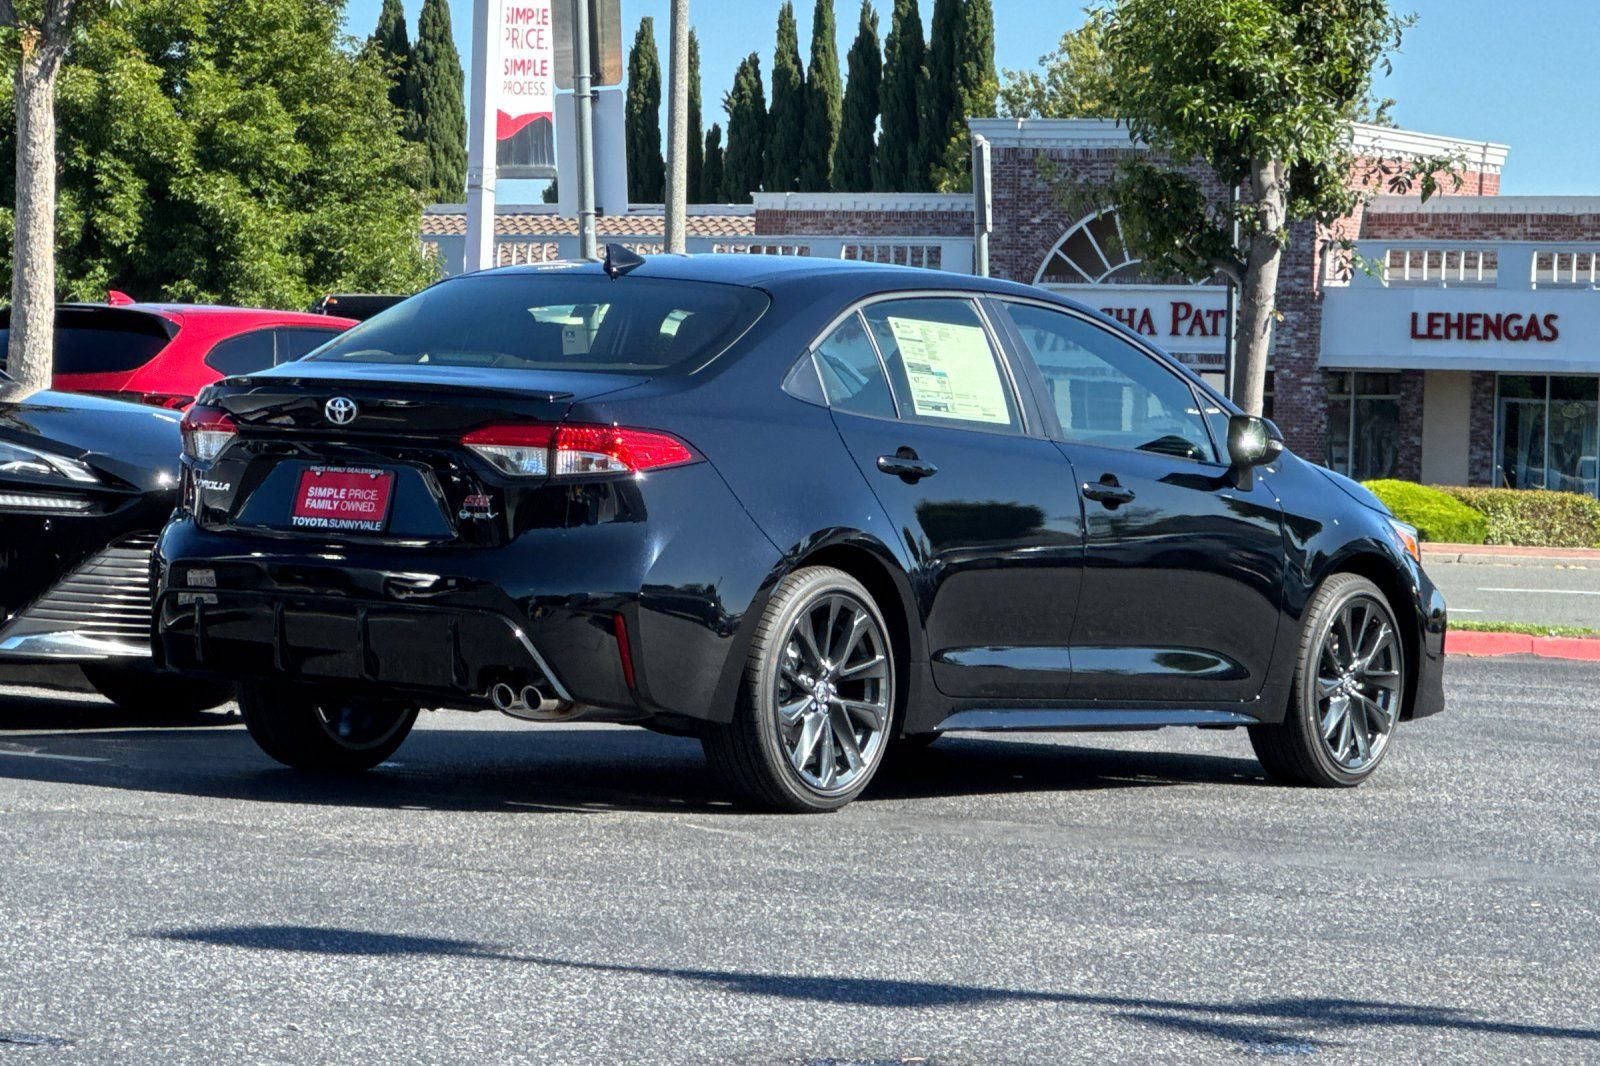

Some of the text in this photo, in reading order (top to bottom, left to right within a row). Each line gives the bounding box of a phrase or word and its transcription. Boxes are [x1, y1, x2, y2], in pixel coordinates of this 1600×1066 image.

[503, 58, 548, 76] SIMPLE
[1100, 301, 1228, 336] HA PAT
[1410, 312, 1559, 342] LEHENGAS
[307, 486, 347, 499] SIMPLE
[304, 498, 377, 512] FAMILY OWNED.
[292, 516, 382, 531] TOYOTA SUNNYVALE
